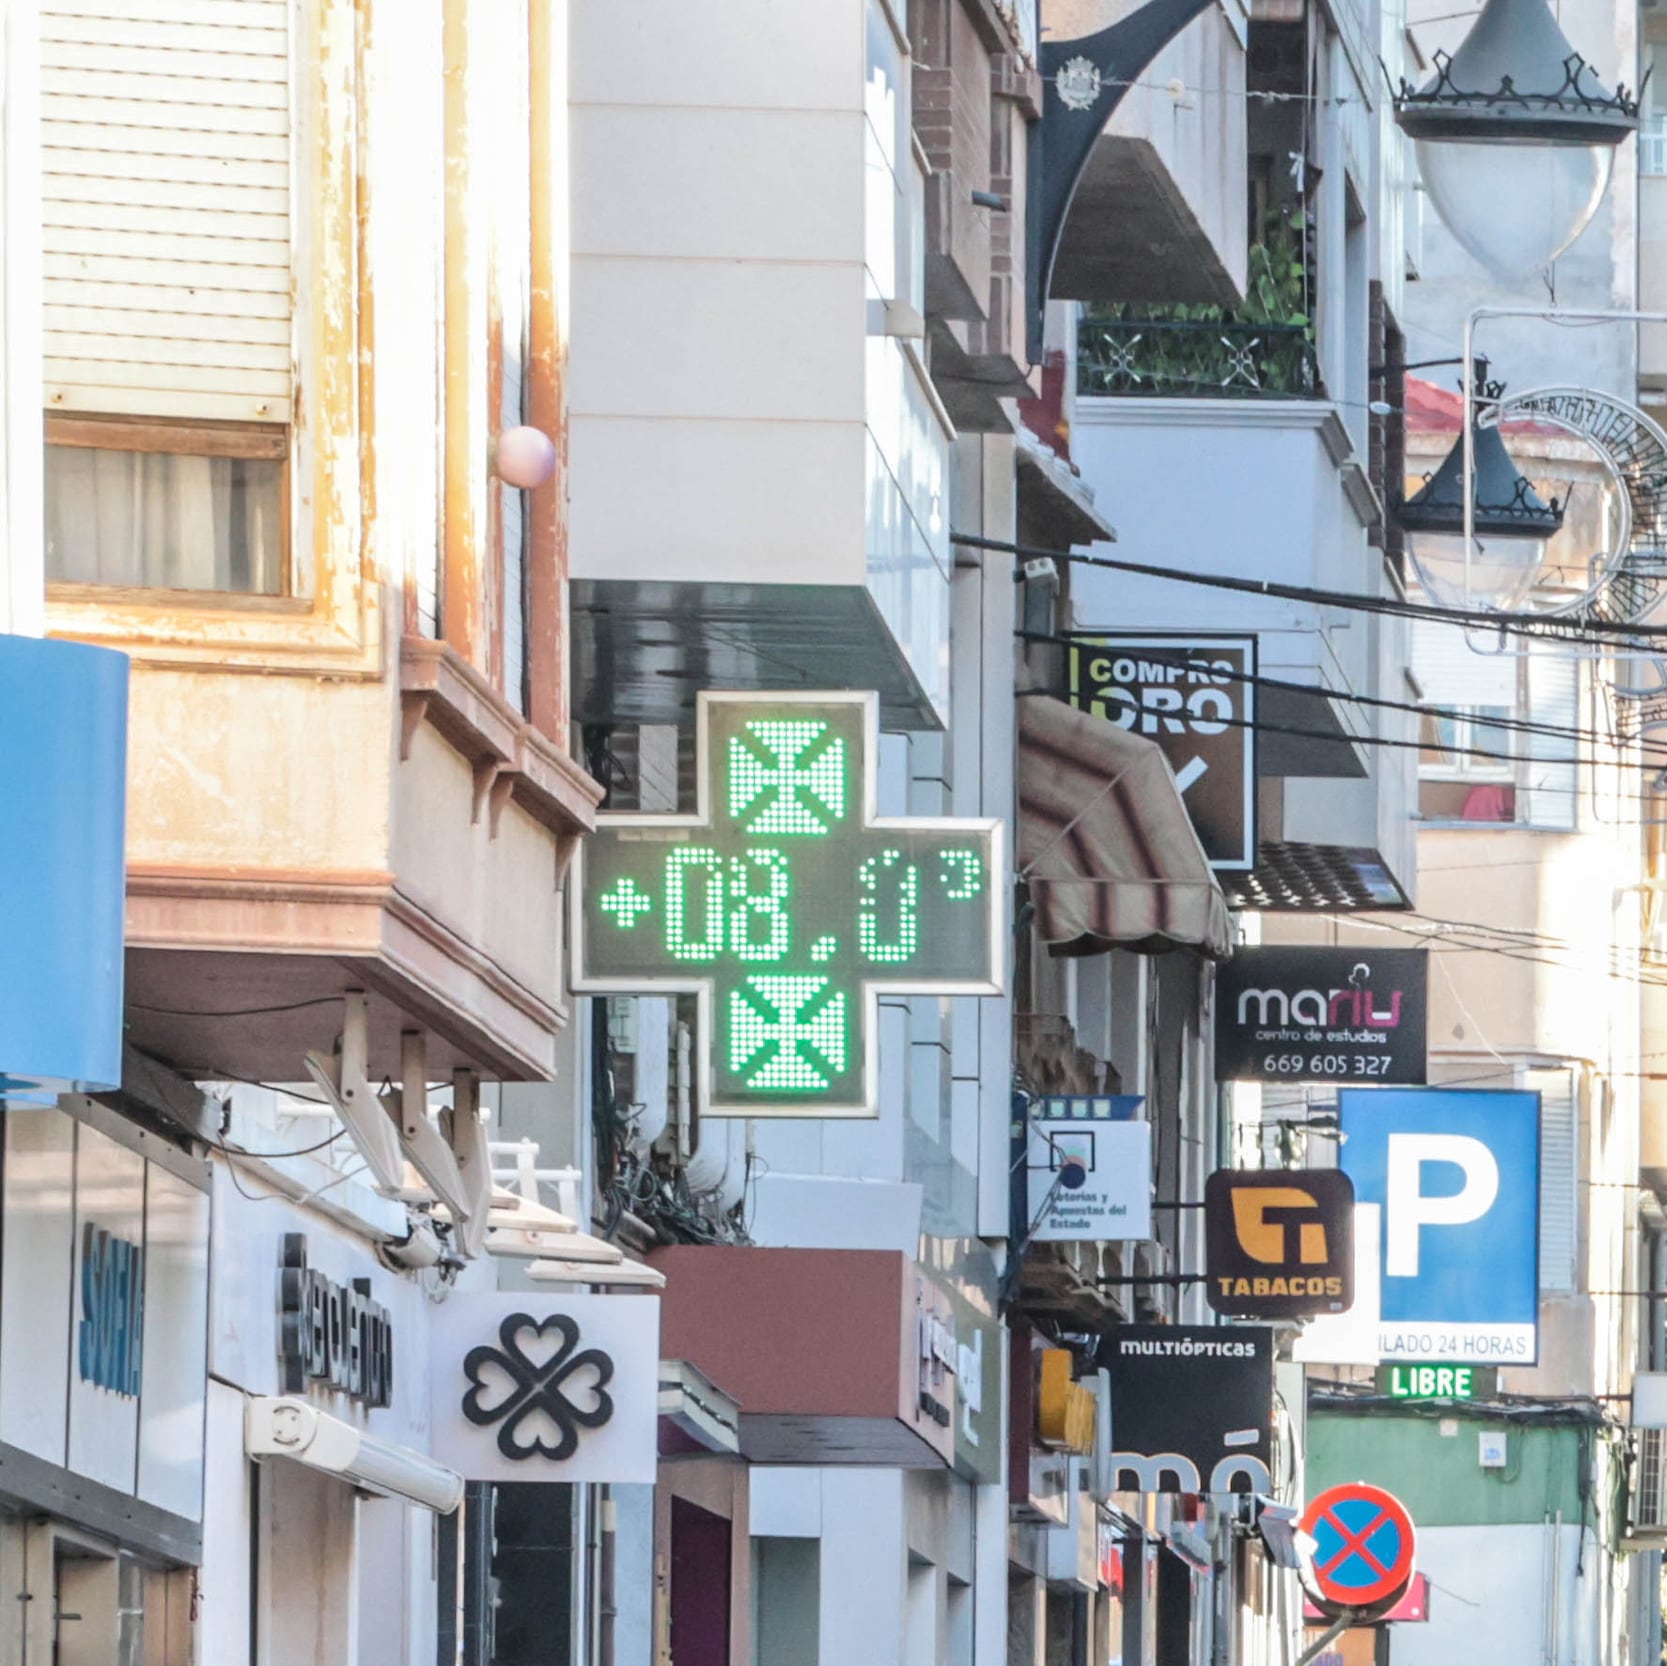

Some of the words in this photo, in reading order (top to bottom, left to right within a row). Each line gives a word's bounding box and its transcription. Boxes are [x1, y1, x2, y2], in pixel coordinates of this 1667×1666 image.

[1090, 658, 1234, 685] COMPRO
[1090, 686, 1234, 735] ORO
[1255, 1027, 1301, 1042] centro
[1304, 1027, 1323, 1042] de
[1326, 1028, 1387, 1044] estudios
[1263, 1054, 1304, 1073] 669
[1310, 1055, 1348, 1074] 605
[1354, 1056, 1392, 1075] 327
[1108, 1205, 1127, 1216] del
[1386, 1132, 1500, 1278] P
[1050, 1218, 1091, 1229] Estado
[1217, 1276, 1343, 1297] TABACOS
[1378, 1333, 1433, 1353] ILADO
[1438, 1335, 1457, 1352] 24
[1463, 1336, 1527, 1355] HORAS
[1391, 1366, 1472, 1396] LIBRE
